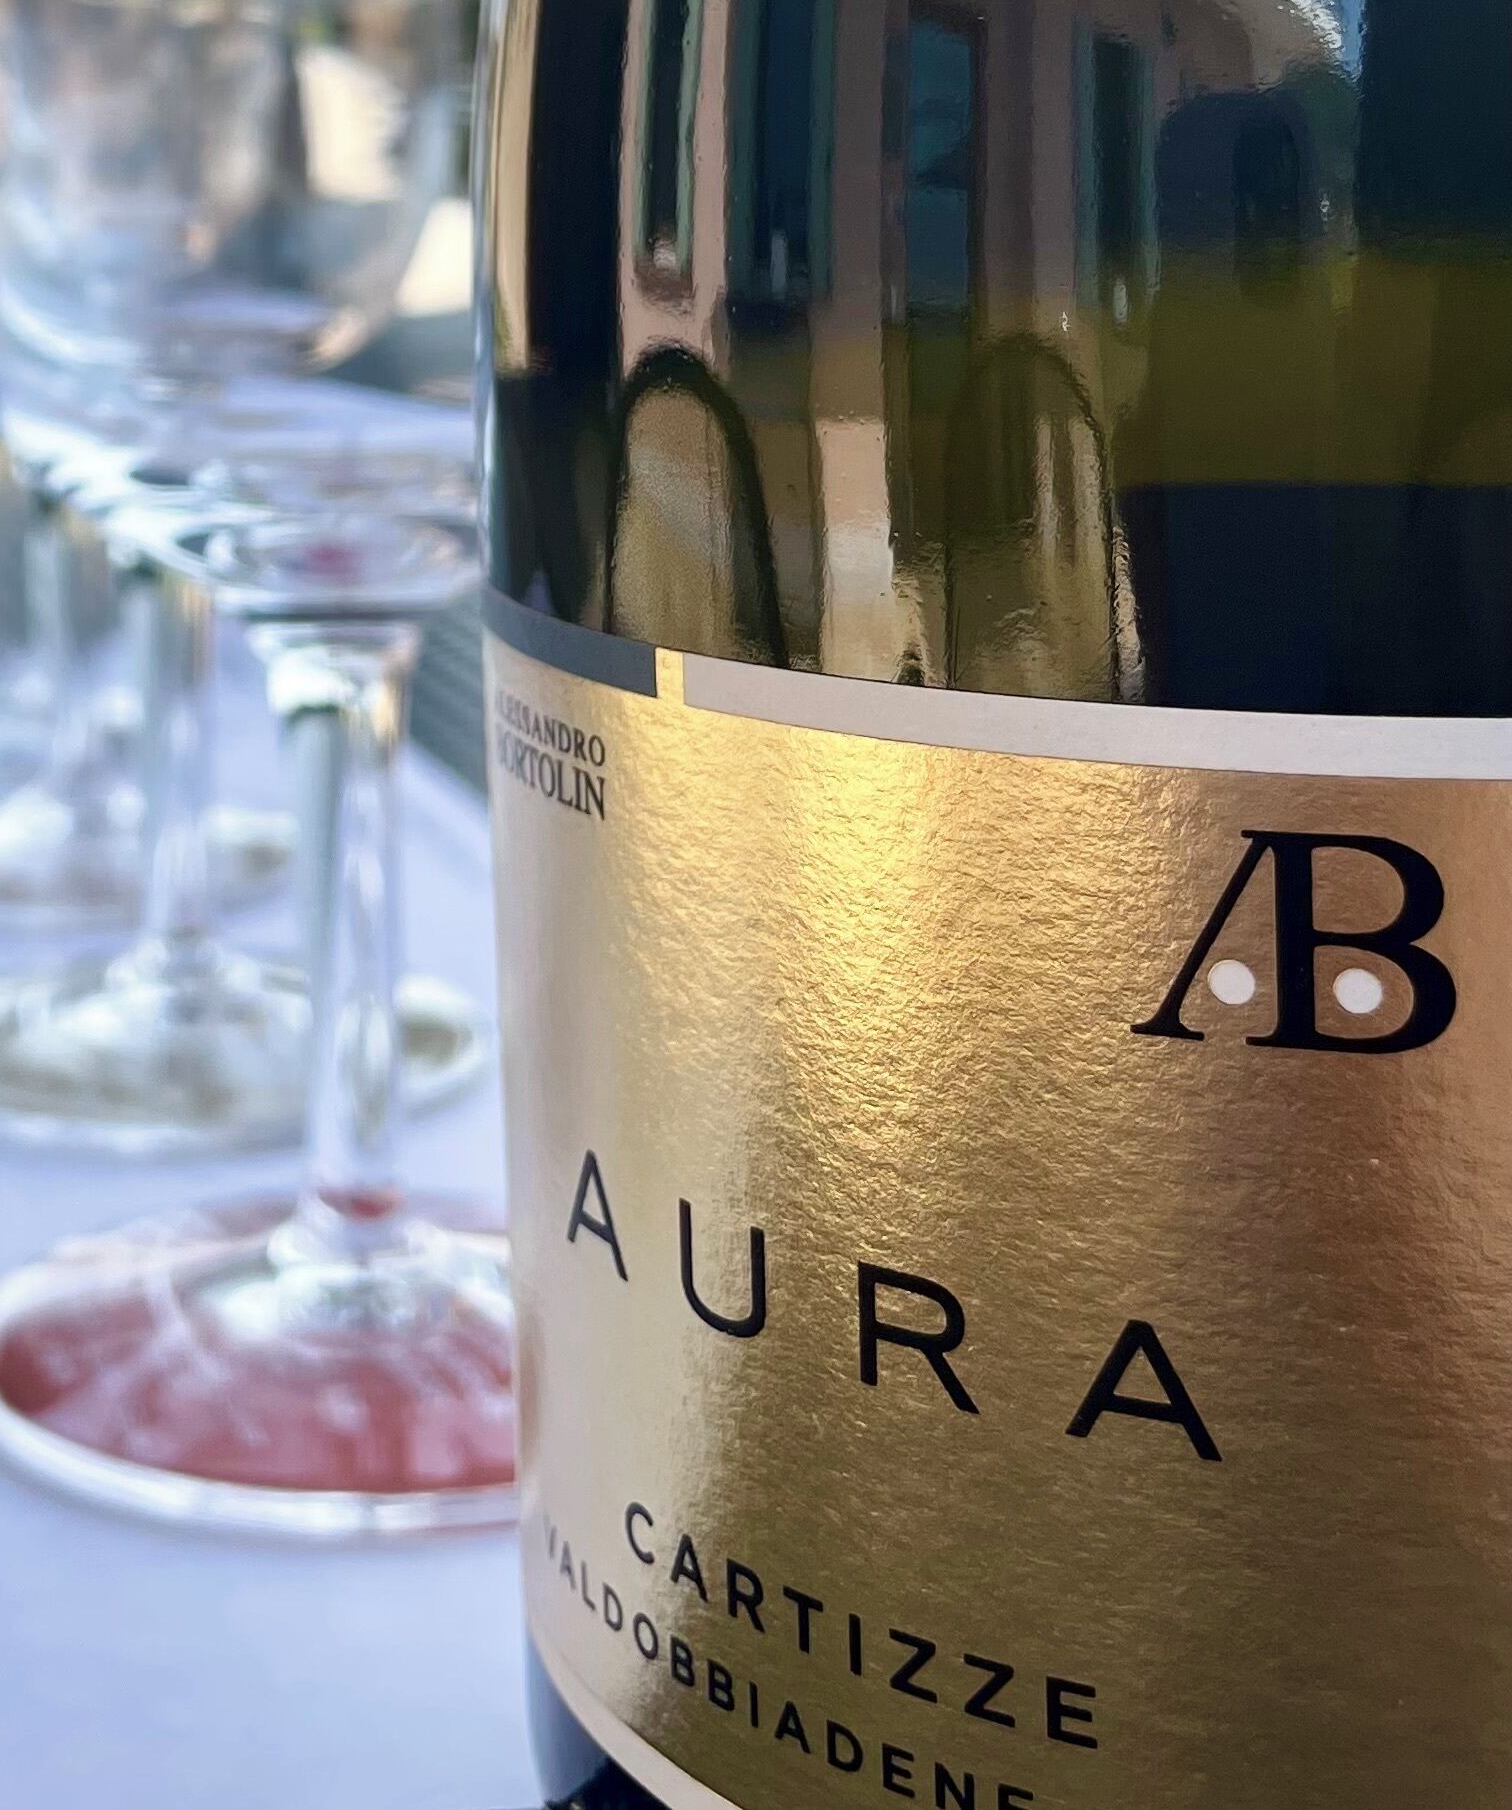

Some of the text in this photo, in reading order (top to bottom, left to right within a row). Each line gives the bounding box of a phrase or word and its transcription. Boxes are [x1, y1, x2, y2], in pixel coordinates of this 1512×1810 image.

[495, 689, 607, 768] LESSANDRO
[496, 722, 607, 822] ORTOLIN
[565, 1148, 1224, 1464] AURA
[624, 1500, 1099, 1750] CARTIZZE
